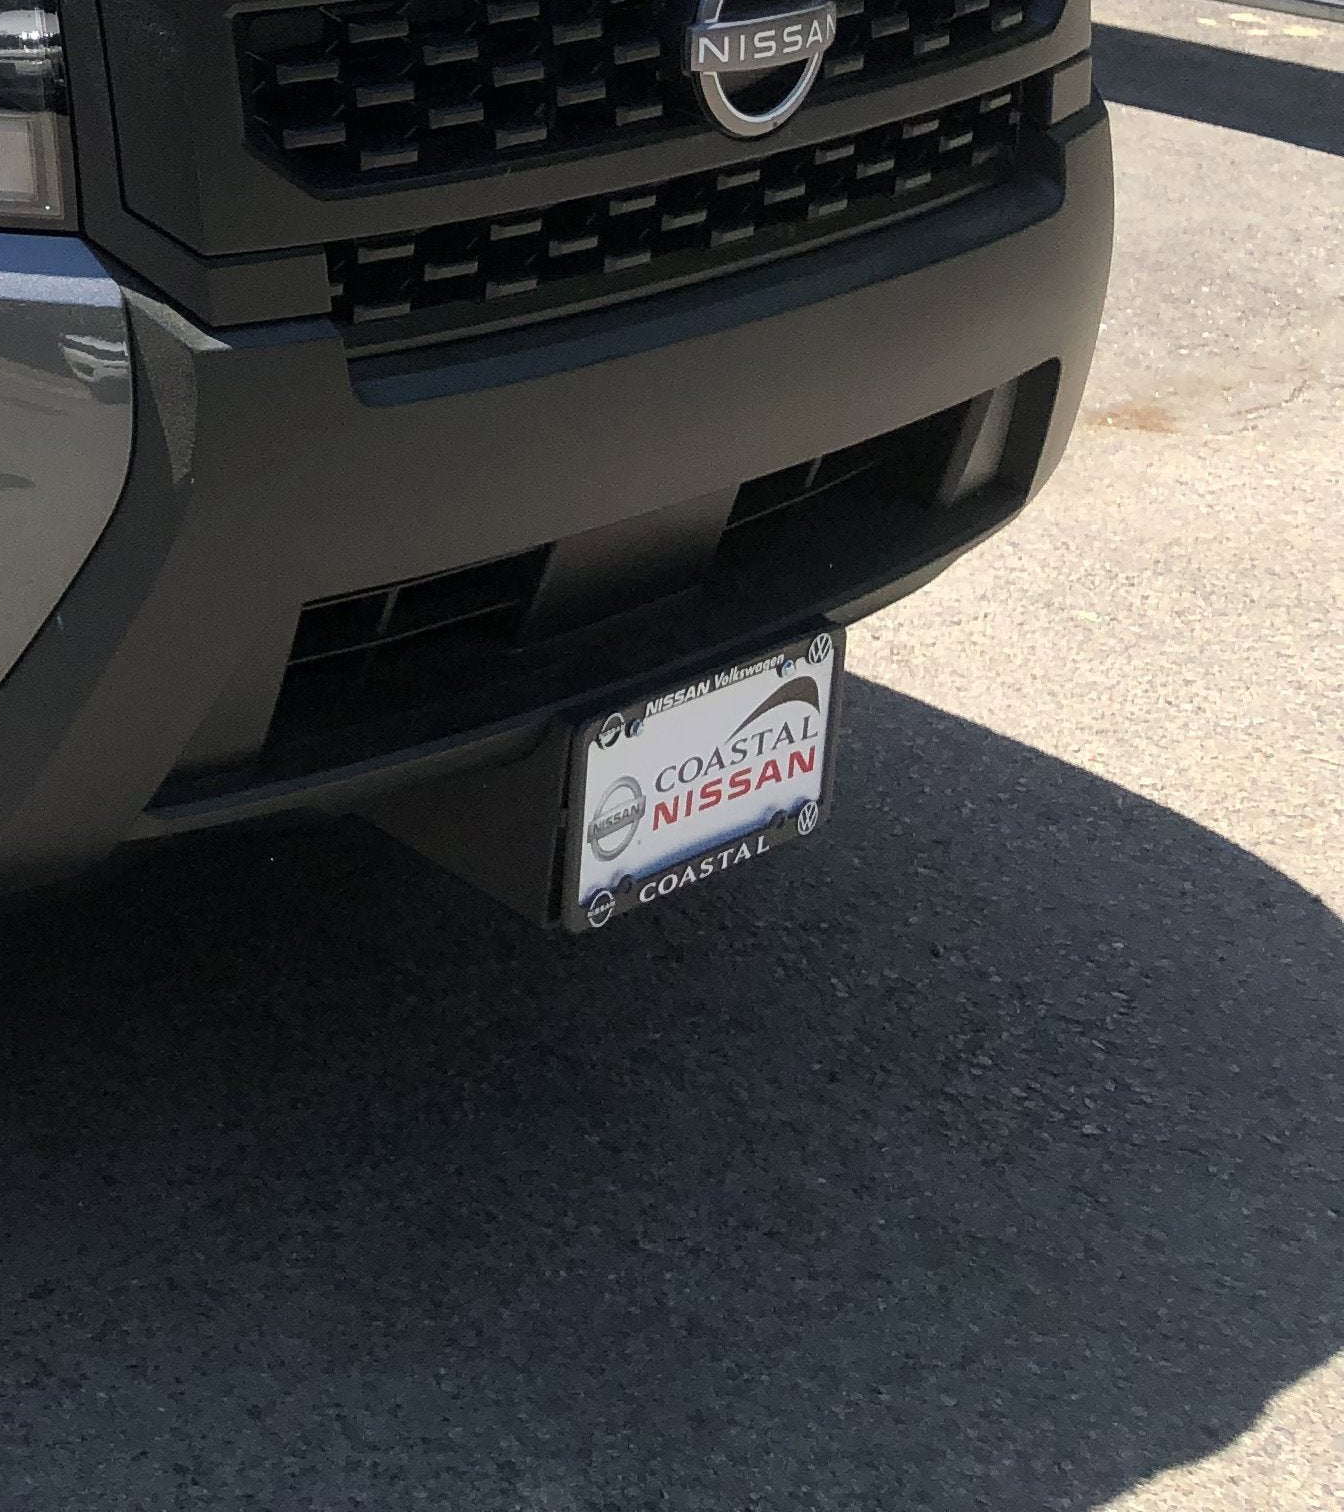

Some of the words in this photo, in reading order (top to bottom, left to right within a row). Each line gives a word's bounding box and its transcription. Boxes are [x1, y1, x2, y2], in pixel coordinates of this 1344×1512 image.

[698, 14, 836, 64] NISSAN
[646, 679, 711, 718] NISSAN
[714, 653, 786, 689] Volkswagen
[655, 715, 819, 794] COASTAL
[592, 802, 641, 840] NISSAN
[652, 746, 816, 831] NISSAN
[639, 835, 771, 904] COASTAL
